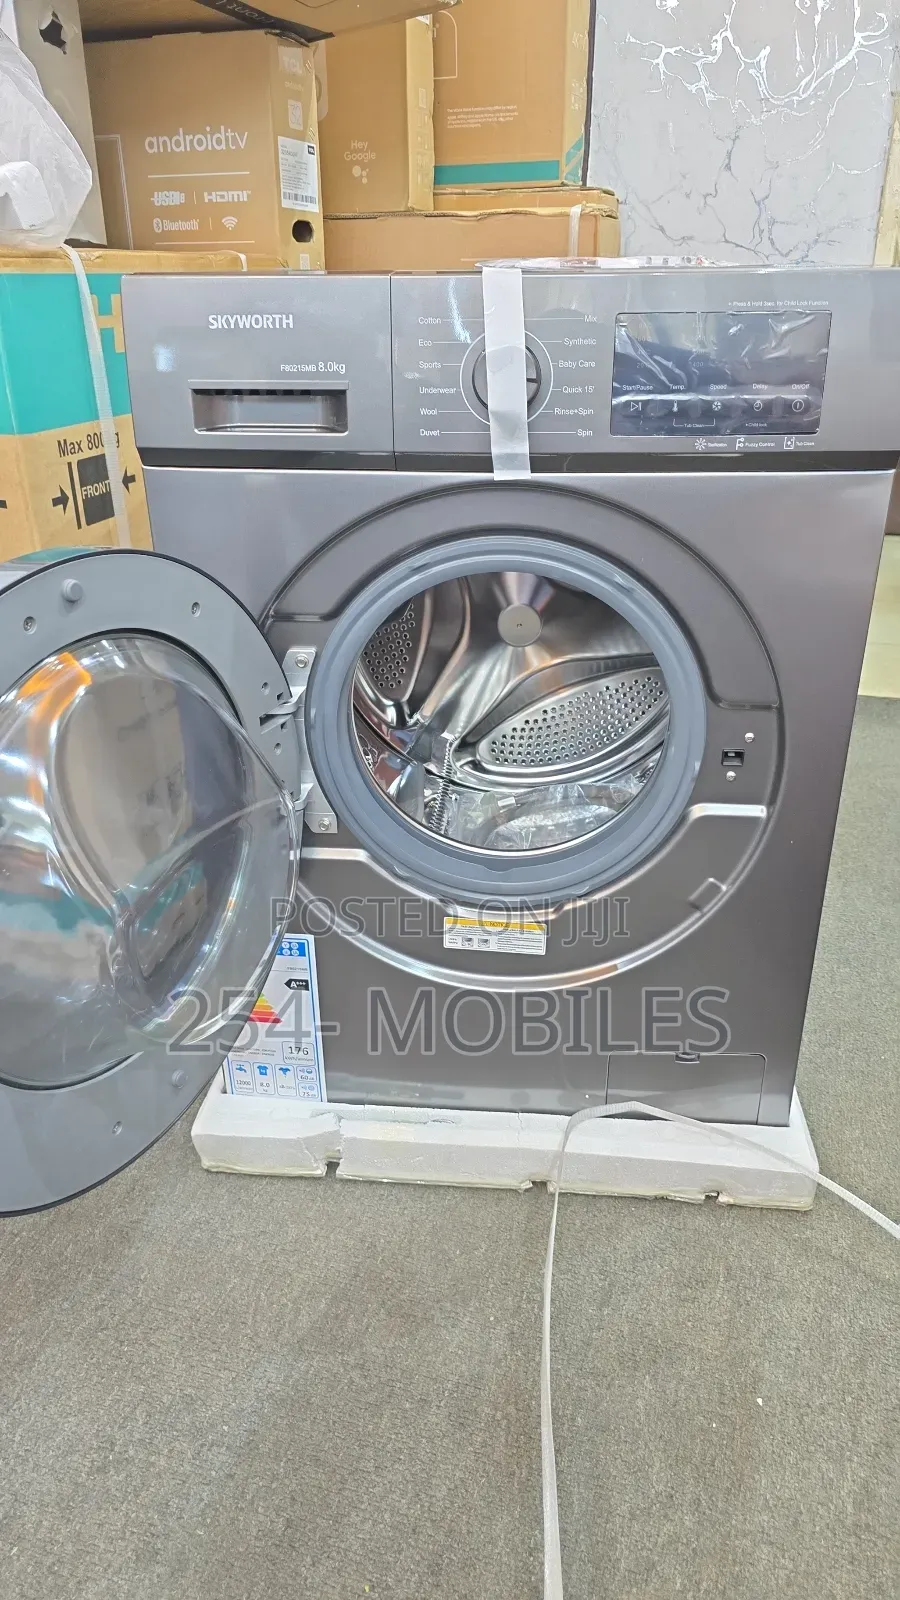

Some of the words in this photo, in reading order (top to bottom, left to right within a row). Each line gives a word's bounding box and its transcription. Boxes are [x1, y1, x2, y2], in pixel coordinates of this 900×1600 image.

[350, 140, 368, 152] Hey
[344, 151, 376, 162] Google
[163, 219, 198, 231] Bluetooth
[208, 314, 294, 329] SKYWORTH
[564, 338, 596, 346] Synthetic
[318, 362, 346, 374] 8.0kg
[418, 361, 442, 369] Sports
[558, 360, 577, 368] Baby
[554, 408, 594, 416] Rinse+Spin
[577, 429, 593, 437] Spin
[57, 438, 84, 458] Max
[82, 480, 110, 500] FRONT
[288, 1046, 309, 1056] 176
